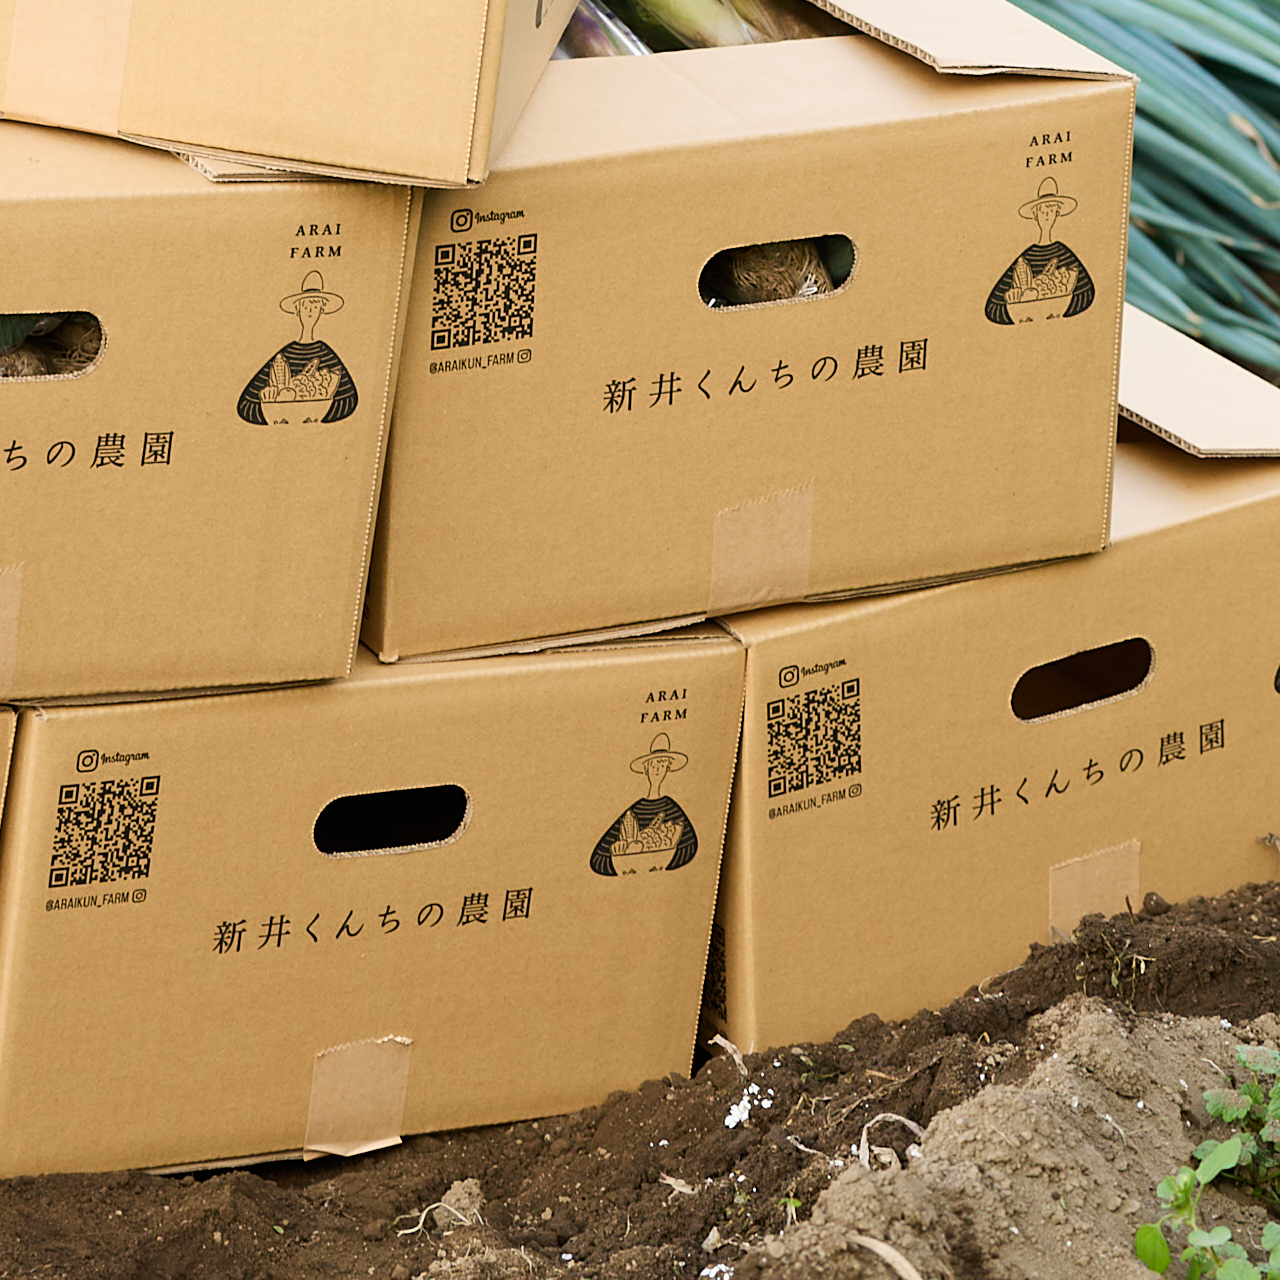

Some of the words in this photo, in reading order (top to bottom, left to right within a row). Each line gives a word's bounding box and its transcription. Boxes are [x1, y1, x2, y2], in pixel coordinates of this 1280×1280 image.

[1028, 130, 1071, 148] ARAI
[1025, 150, 1073, 168] FARM
[474, 209, 526, 226] Instagram
[294, 223, 341, 237] ARAI
[289, 244, 343, 259] FARM
[428, 351, 515, 375] @ARAIKUN_FARM
[602, 337, 929, 414] 新井くんちの農園
[800, 658, 847, 679] Instagram
[644, 688, 687, 704] ARAI
[639, 707, 688, 724] FARM
[100, 751, 151, 767] Instagram
[930, 717, 1226, 832] 新井くんちの農園
[767, 787, 847, 821] @ARAIKUN_FARM
[45, 890, 130, 912] @ARAIKUN_FARM
[212, 886, 534, 955] 新井くんちの農園
